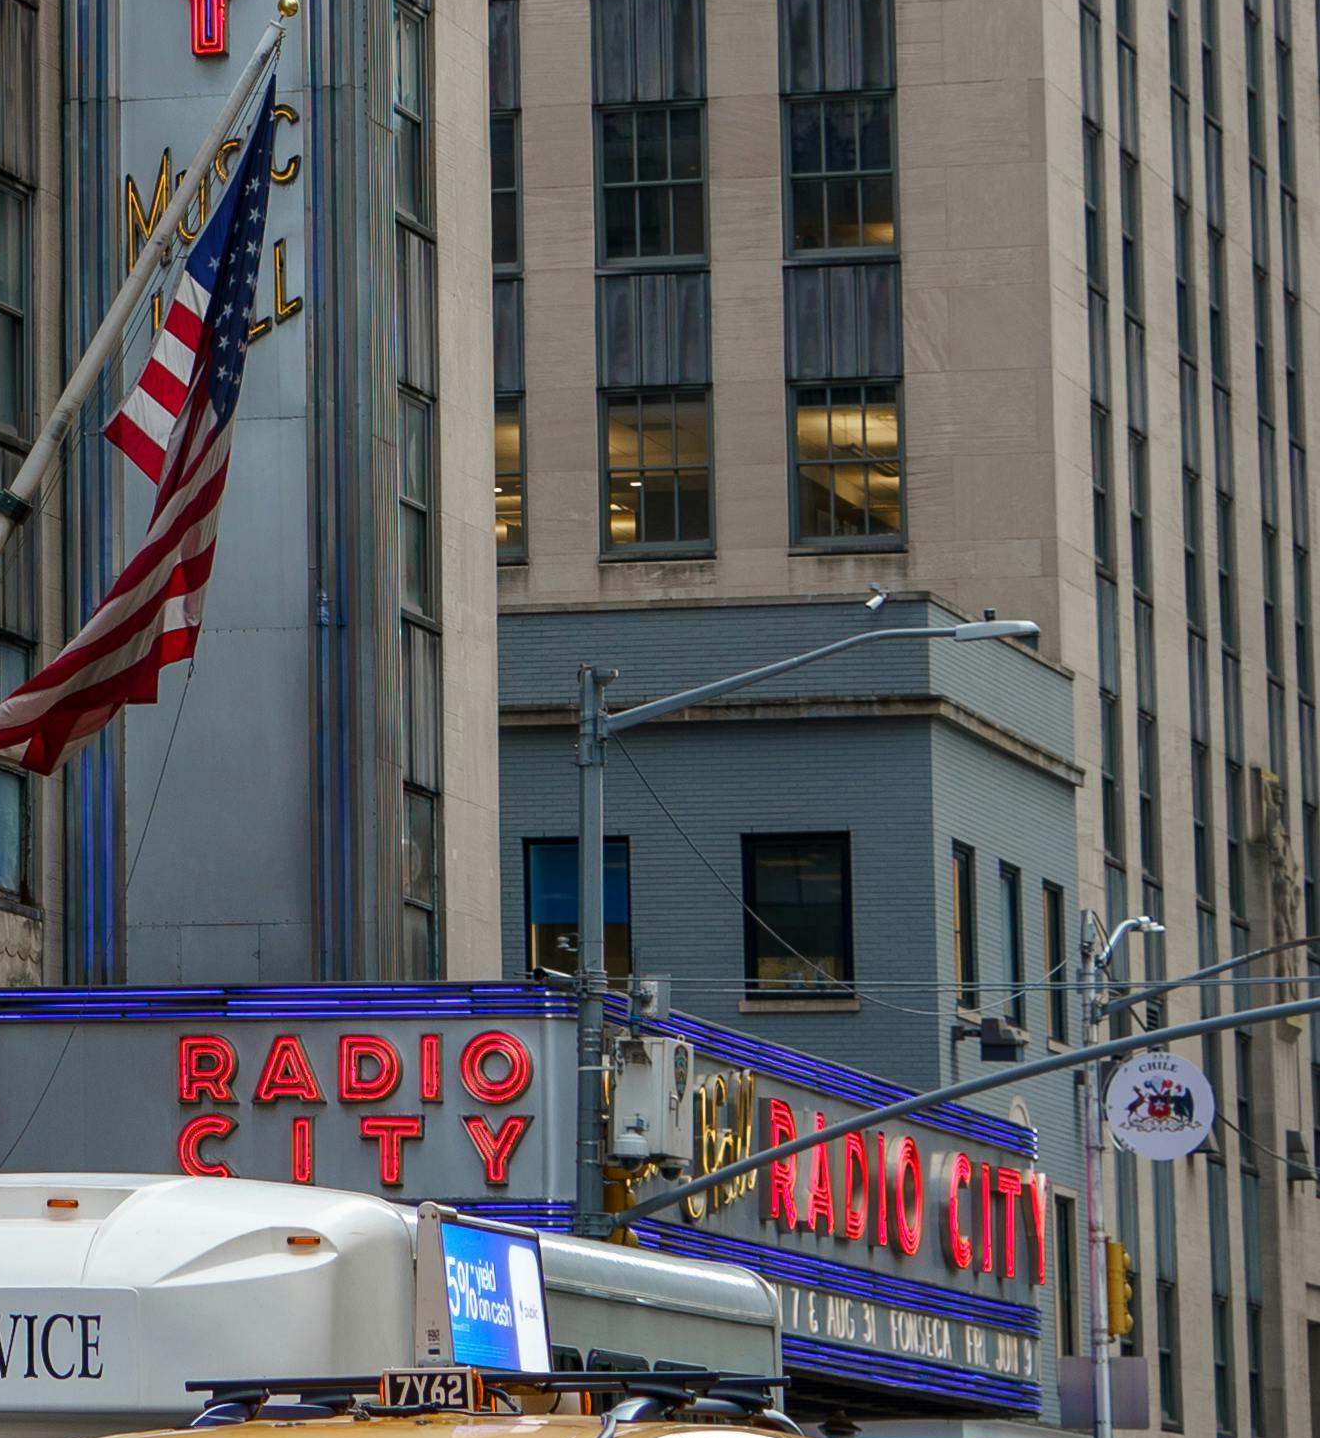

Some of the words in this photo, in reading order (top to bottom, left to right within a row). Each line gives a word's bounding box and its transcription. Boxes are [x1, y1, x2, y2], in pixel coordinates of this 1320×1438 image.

[178, 1030, 534, 1105] RADIO
[1138, 1062, 1179, 1074] CHILE
[178, 1112, 535, 1187] CITY
[768, 1097, 923, 1257] RADIO
[948, 1151, 1048, 1285] CITY
[474, 1259, 497, 1296] yield
[479, 1297, 492, 1322] on
[491, 1297, 513, 1328] cash
[827, 1295, 855, 1341] AUG
[863, 1302, 877, 1345] 31
[889, 1309, 953, 1361] FONSECA
[995, 1333, 1019, 1375] JUN
[1023, 1339, 1032, 1376] 9
[396, 1374, 463, 1407] 7Y62
